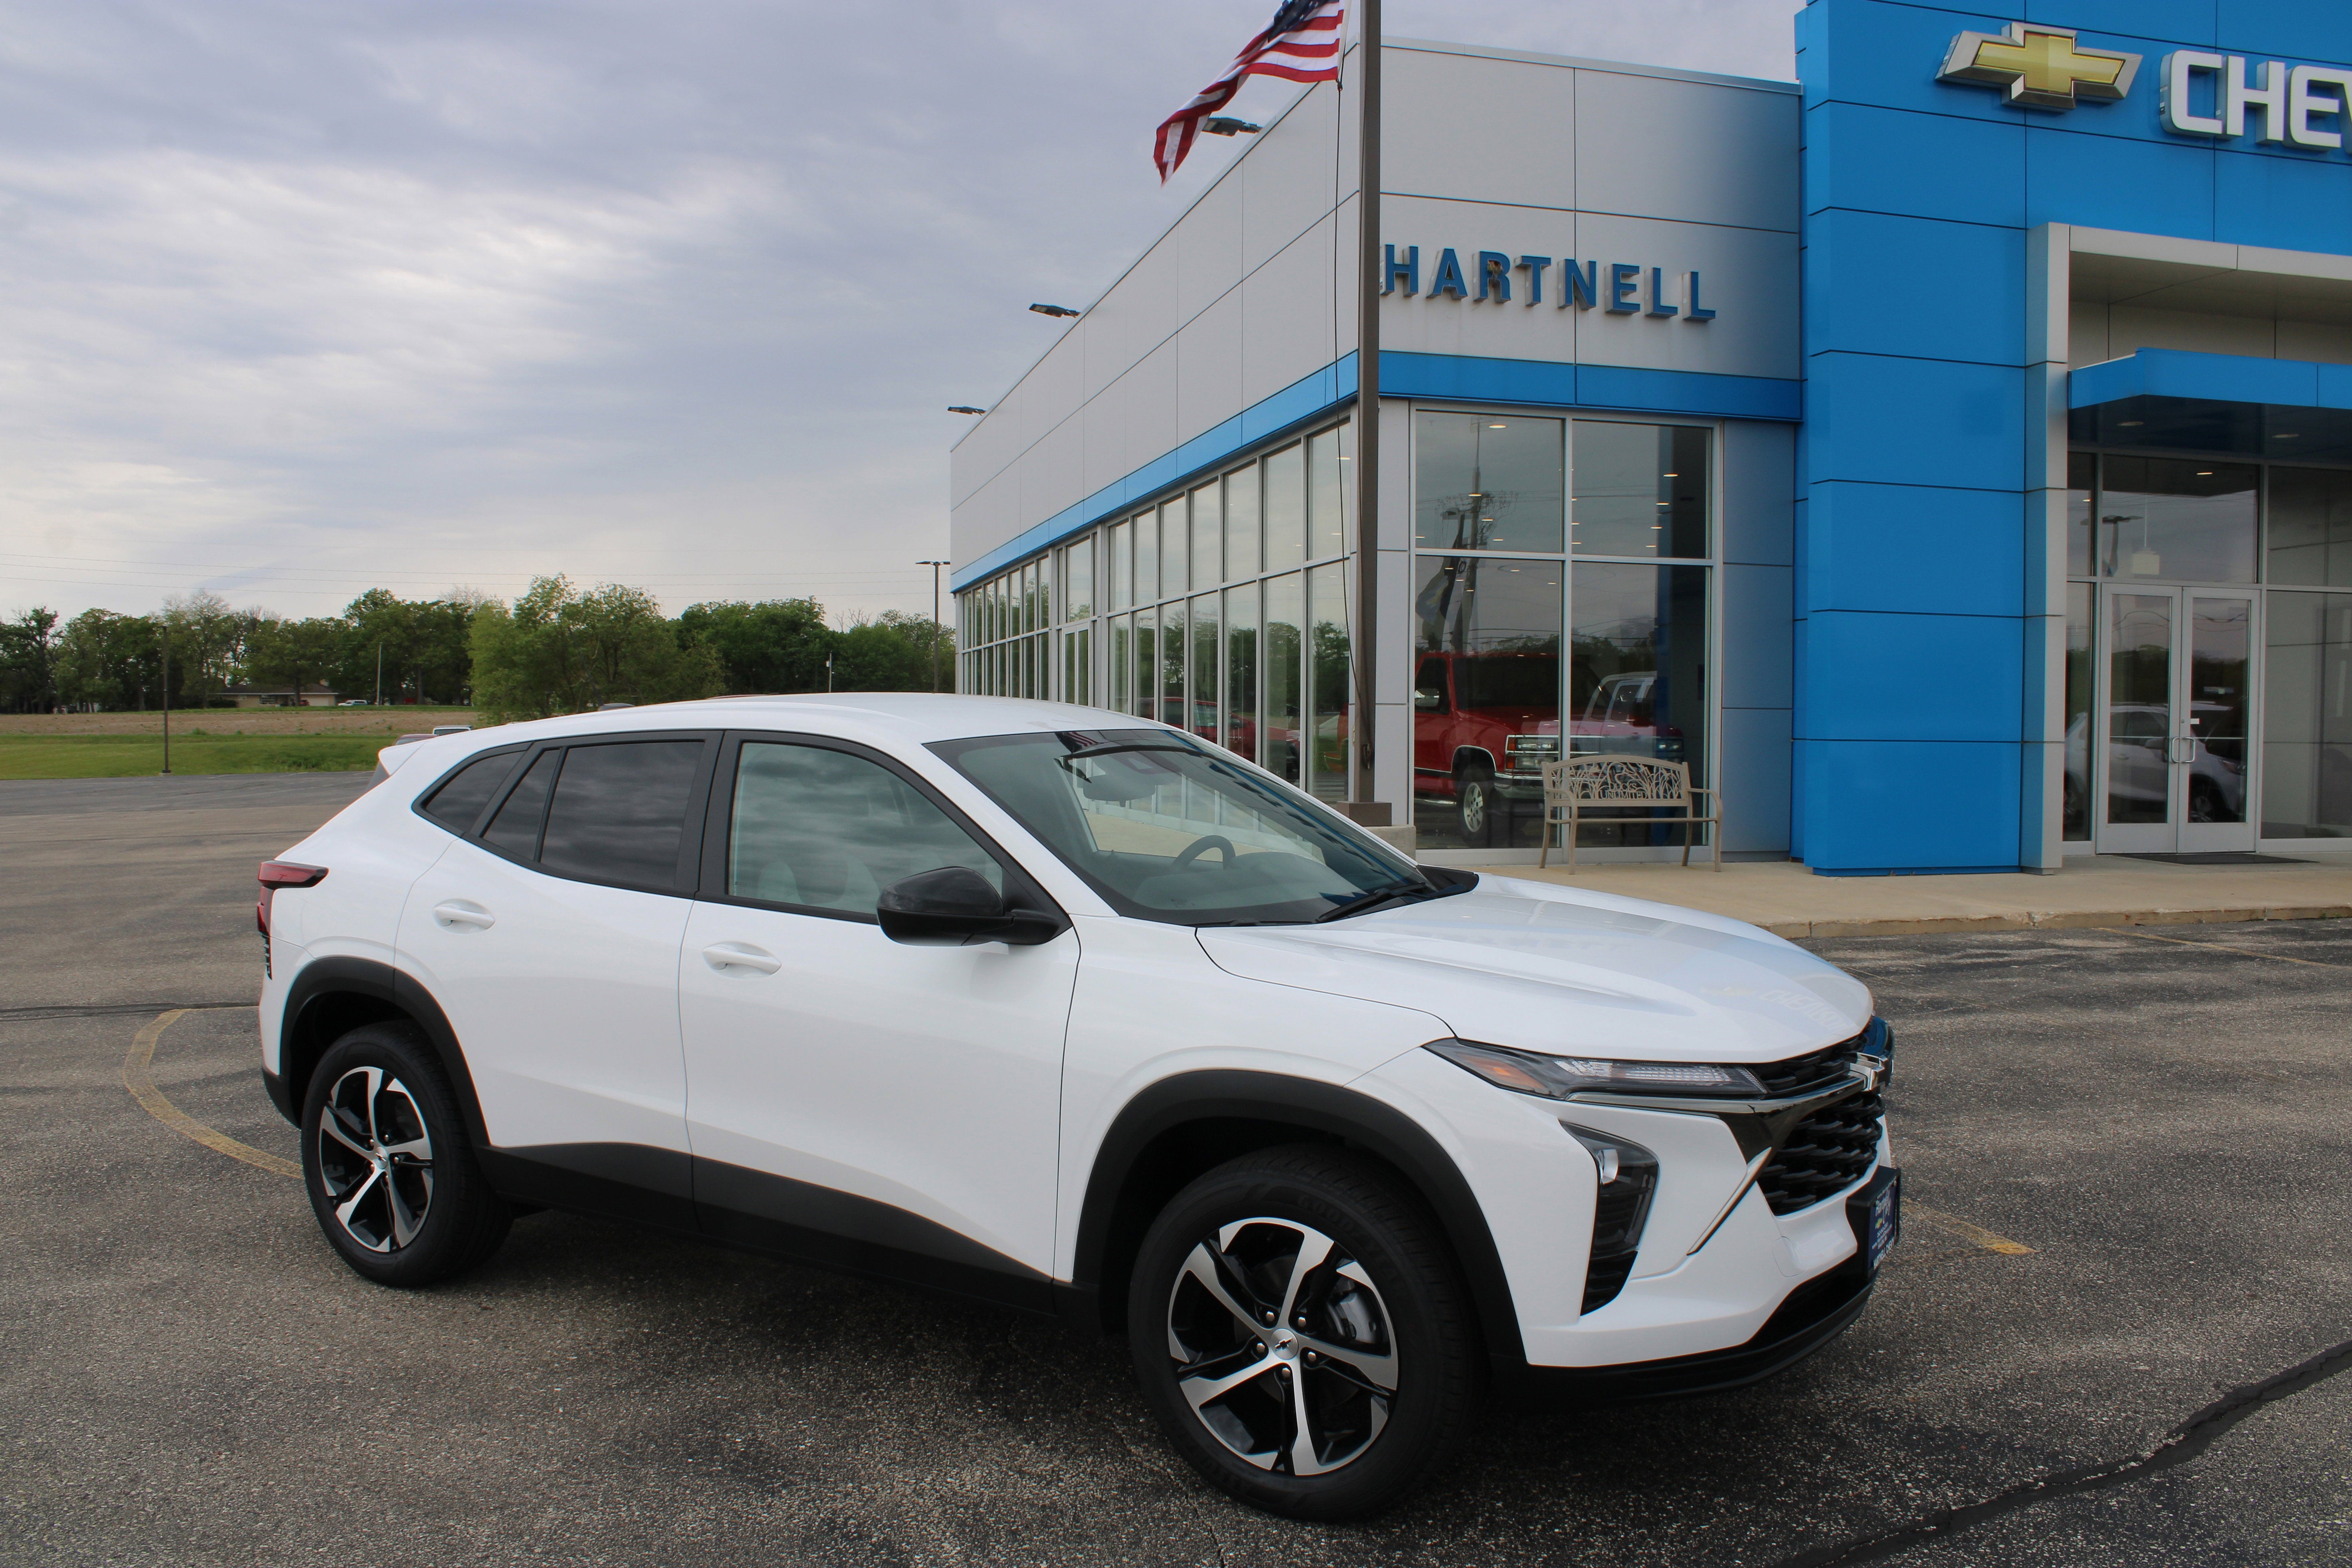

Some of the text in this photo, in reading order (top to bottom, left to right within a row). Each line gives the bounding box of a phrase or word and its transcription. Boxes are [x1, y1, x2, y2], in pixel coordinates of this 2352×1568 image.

[2160, 49, 2352, 154] CHE
[1379, 244, 1715, 321] HARTNELL
[1600, 790, 1647, 799] UNLIMITED
[1609, 782, 1637, 791] DUCKS
